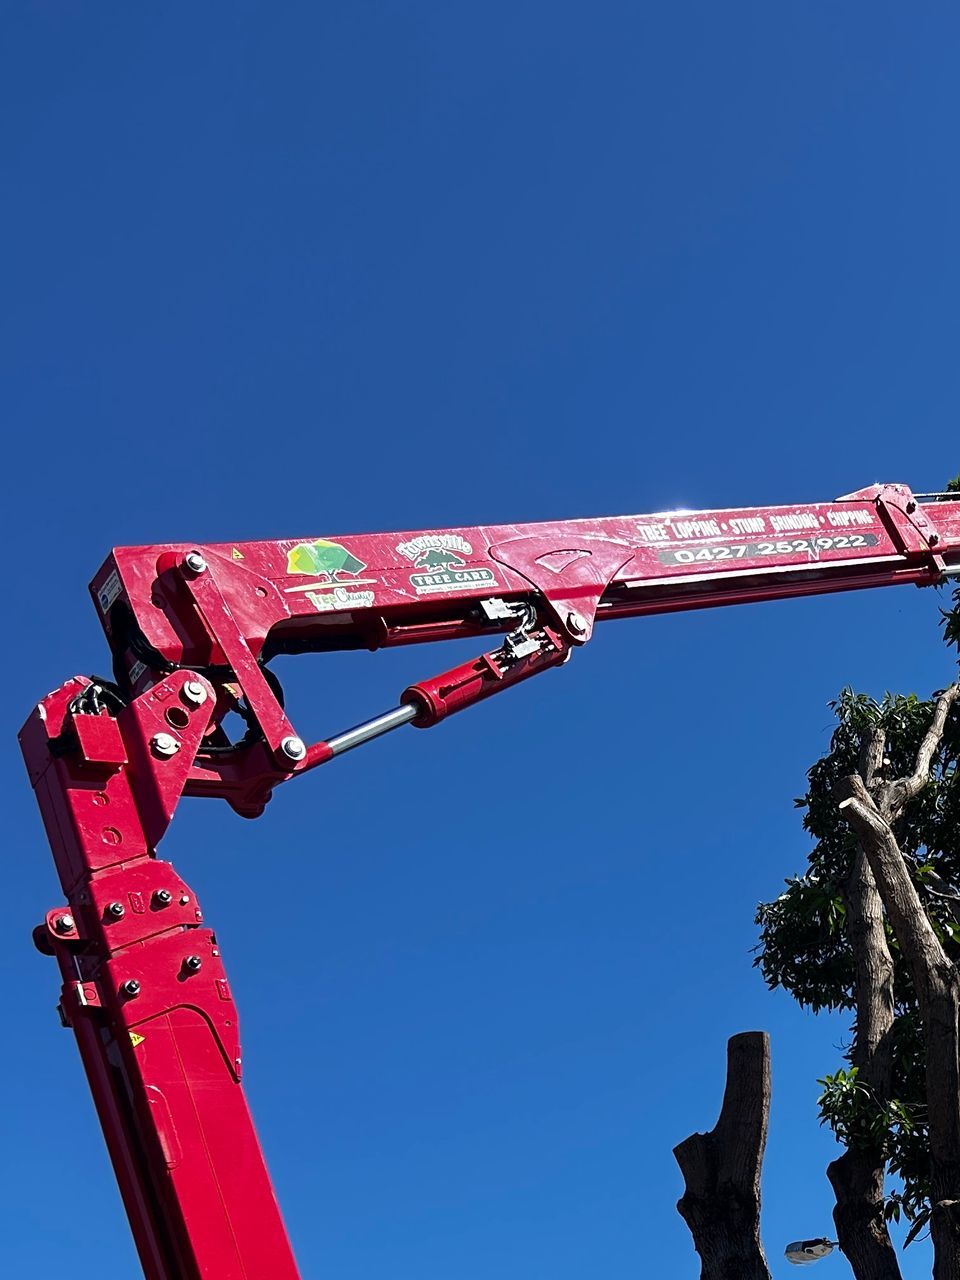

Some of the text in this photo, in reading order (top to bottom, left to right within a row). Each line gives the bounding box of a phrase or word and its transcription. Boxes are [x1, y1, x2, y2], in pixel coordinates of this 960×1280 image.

[637, 509, 874, 541] TREE LOPPING STUMP GRINDING CHIPPING
[397, 535, 471, 560] Townsville
[674, 535, 868, 562] 0427 252 922
[414, 571, 490, 586] TREE CARE
